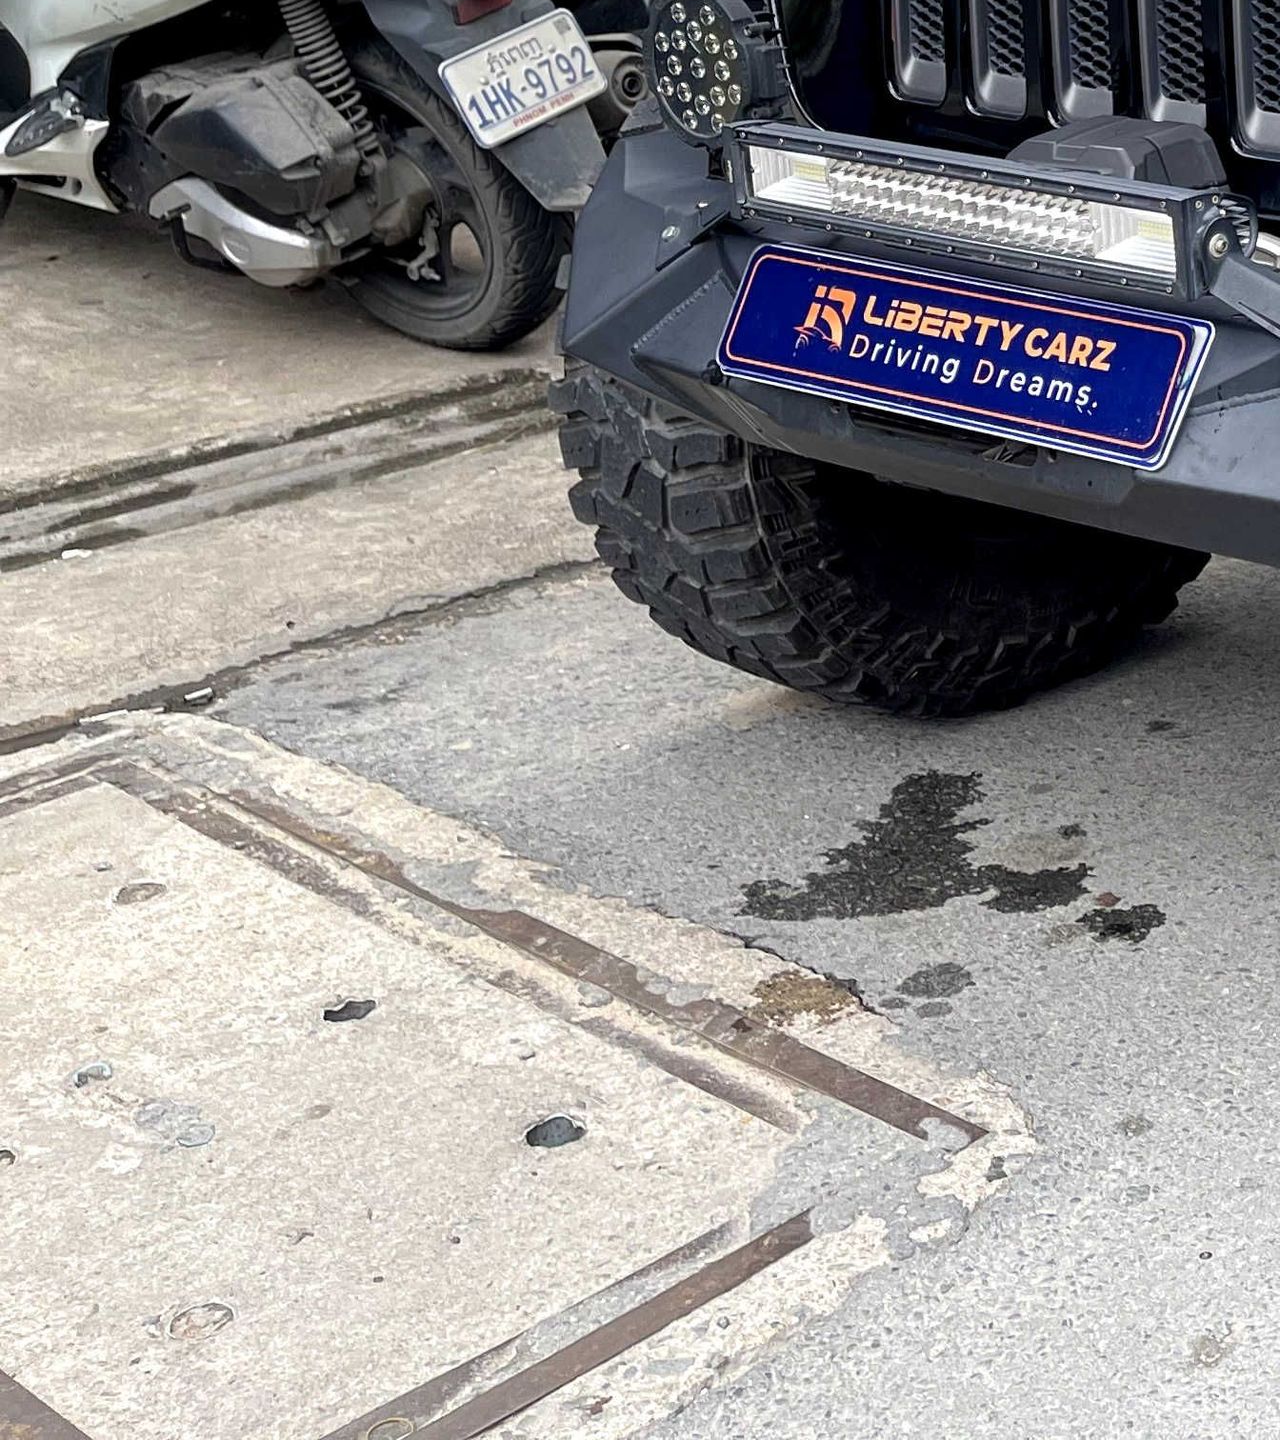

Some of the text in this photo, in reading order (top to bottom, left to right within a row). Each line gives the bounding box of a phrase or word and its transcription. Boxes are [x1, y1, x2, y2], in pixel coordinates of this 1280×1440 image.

[468, 46, 594, 128] 1HK-9792
[512, 92, 576, 128] PHNOM PENH
[849, 334, 960, 384] Driving
[1024, 328, 1117, 371] CARZ
